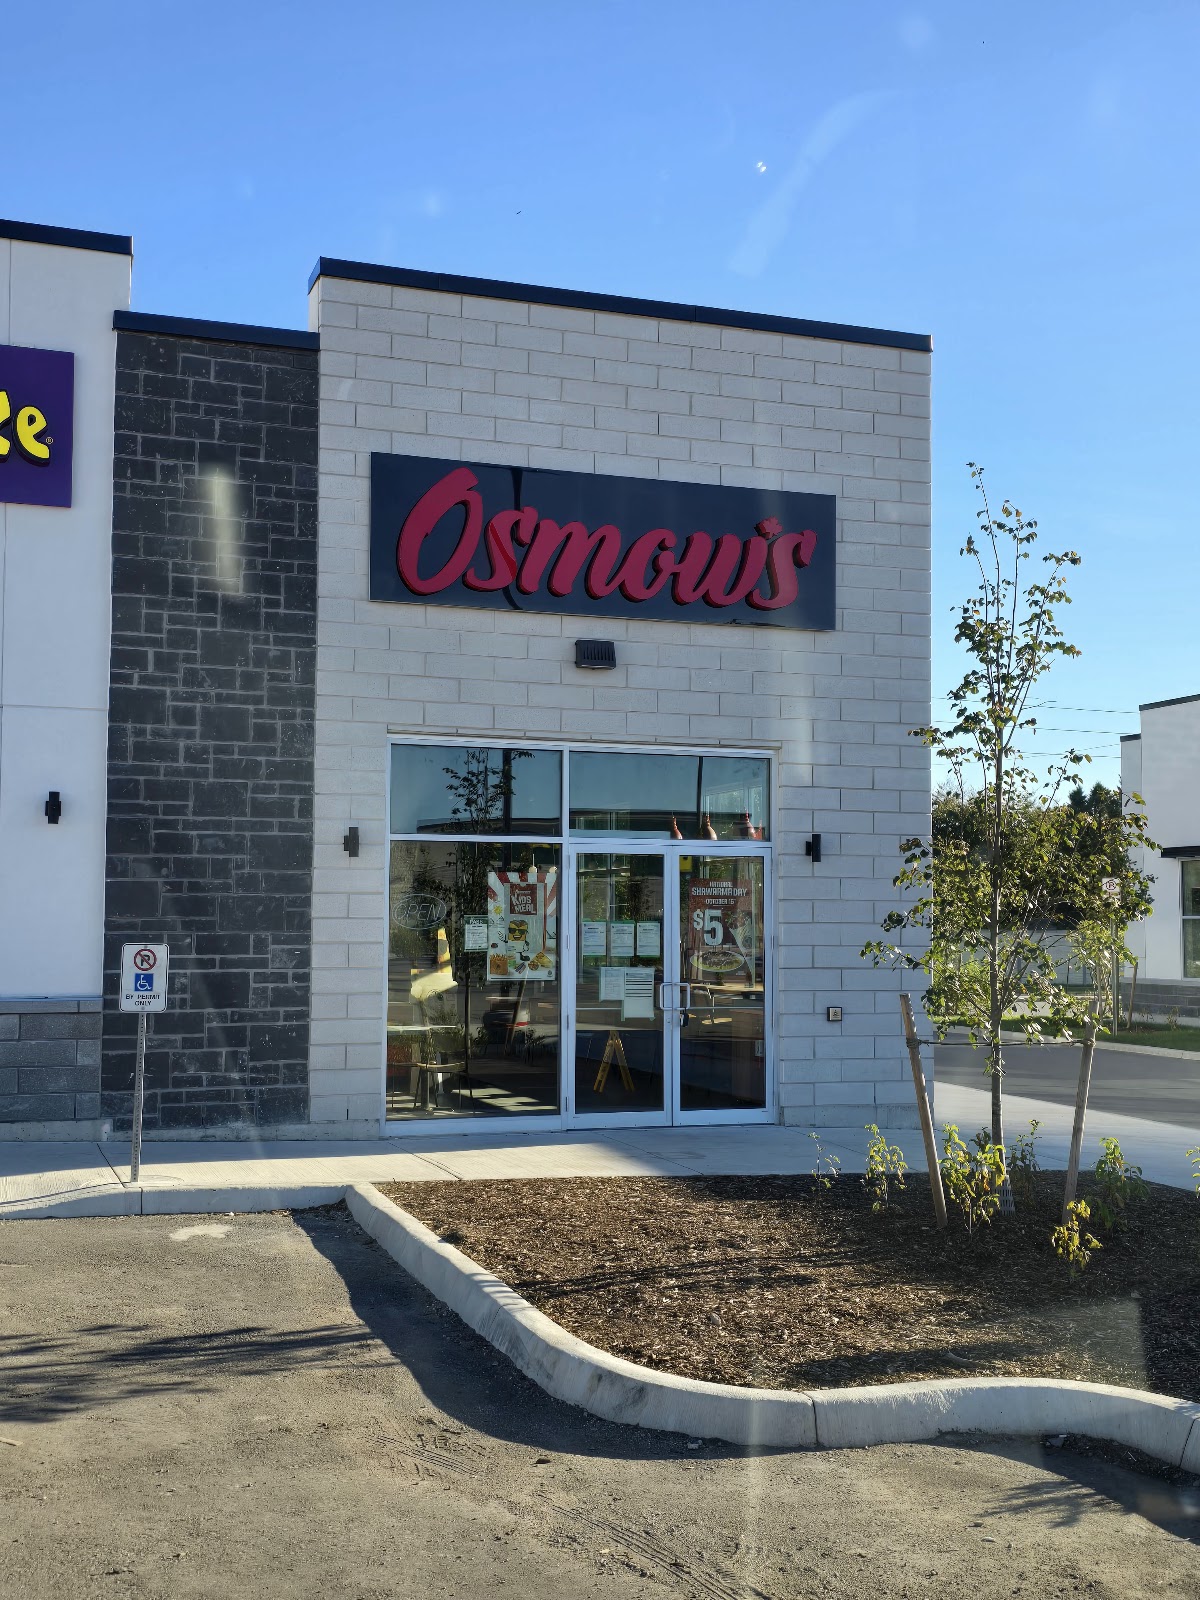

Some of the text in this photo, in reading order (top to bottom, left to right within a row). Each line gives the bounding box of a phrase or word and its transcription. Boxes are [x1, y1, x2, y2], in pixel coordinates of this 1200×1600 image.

[397, 466, 818, 612] Osmow's
[691, 887, 748, 896] SHAWARMA DAY
[511, 894, 532, 906] KIDS
[394, 903, 442, 922] OPEN
[514, 904, 536, 913] MEAL
[692, 908, 724, 946] $5
